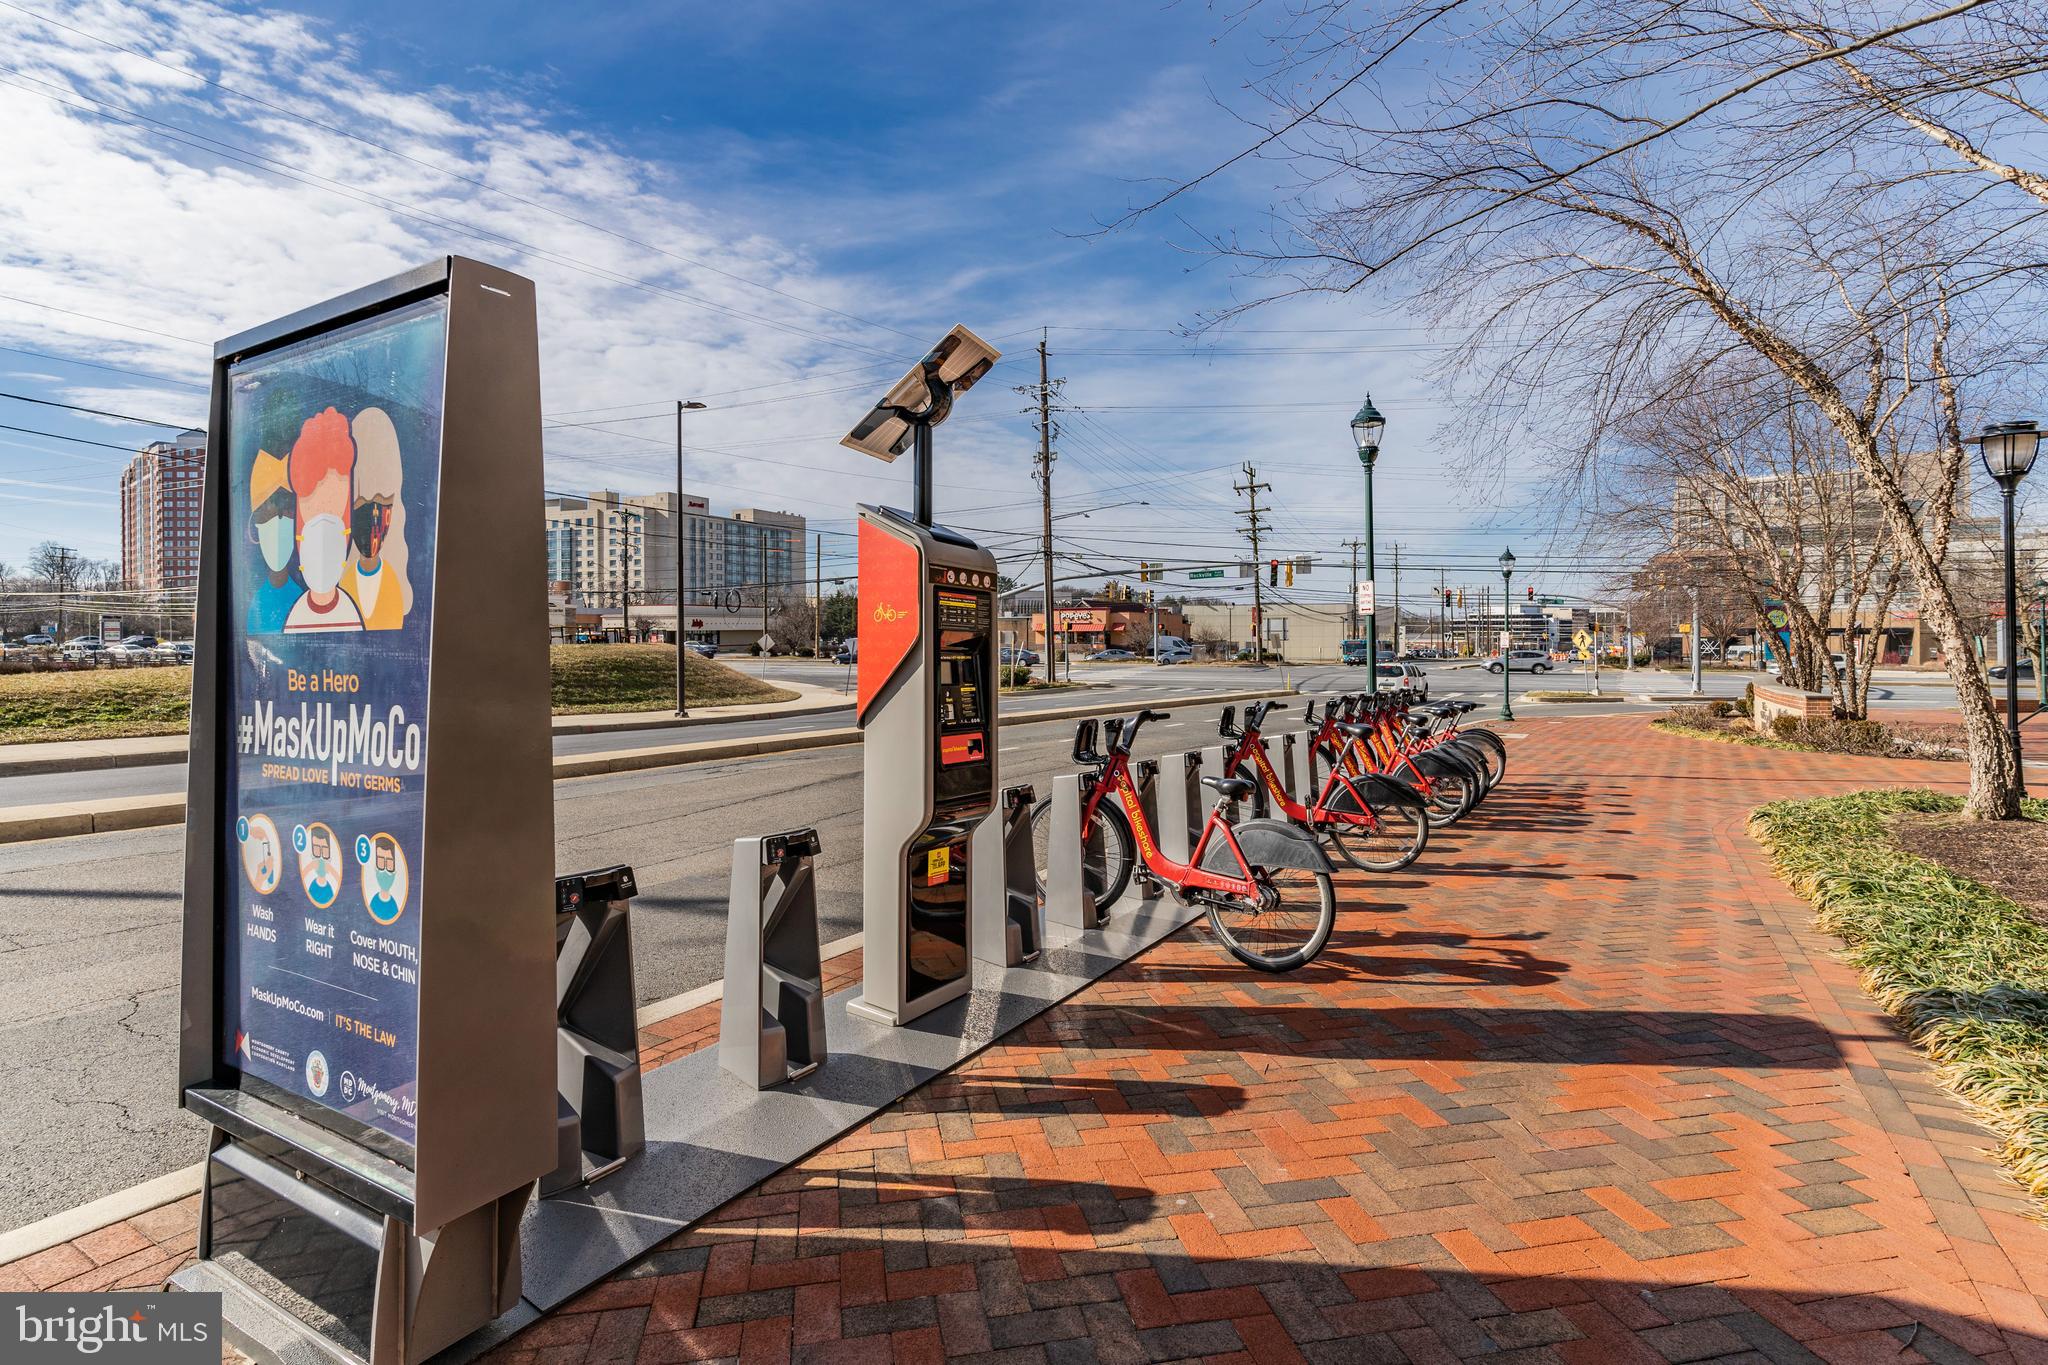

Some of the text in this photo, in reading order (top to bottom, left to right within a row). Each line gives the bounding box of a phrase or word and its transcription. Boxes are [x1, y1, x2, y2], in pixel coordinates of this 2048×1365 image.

[288, 669, 359, 693] Be a Hero
[237, 700, 421, 786] #MaskUpMoCo
[261, 763, 401, 793] SPREAD LOVE NOT GERMS
[1253, 749, 1286, 807] capital bikeshare
[240, 823, 246, 836] 1
[1117, 774, 1153, 859] capital bikeshare
[297, 832, 303, 845] 2
[360, 842, 367, 856] 3
[252, 904, 274, 922] Wash
[247, 924, 277, 943] HANDS
[305, 917, 335, 938] Wear it
[306, 939, 333, 959] RIGHT
[350, 930, 418, 965] Cover MOUTH,
[353, 952, 416, 985] NOSE & CHIN
[251, 986, 324, 1022] MaskUpMoCo.com
[335, 1014, 397, 1048] IT'S THE LAW
